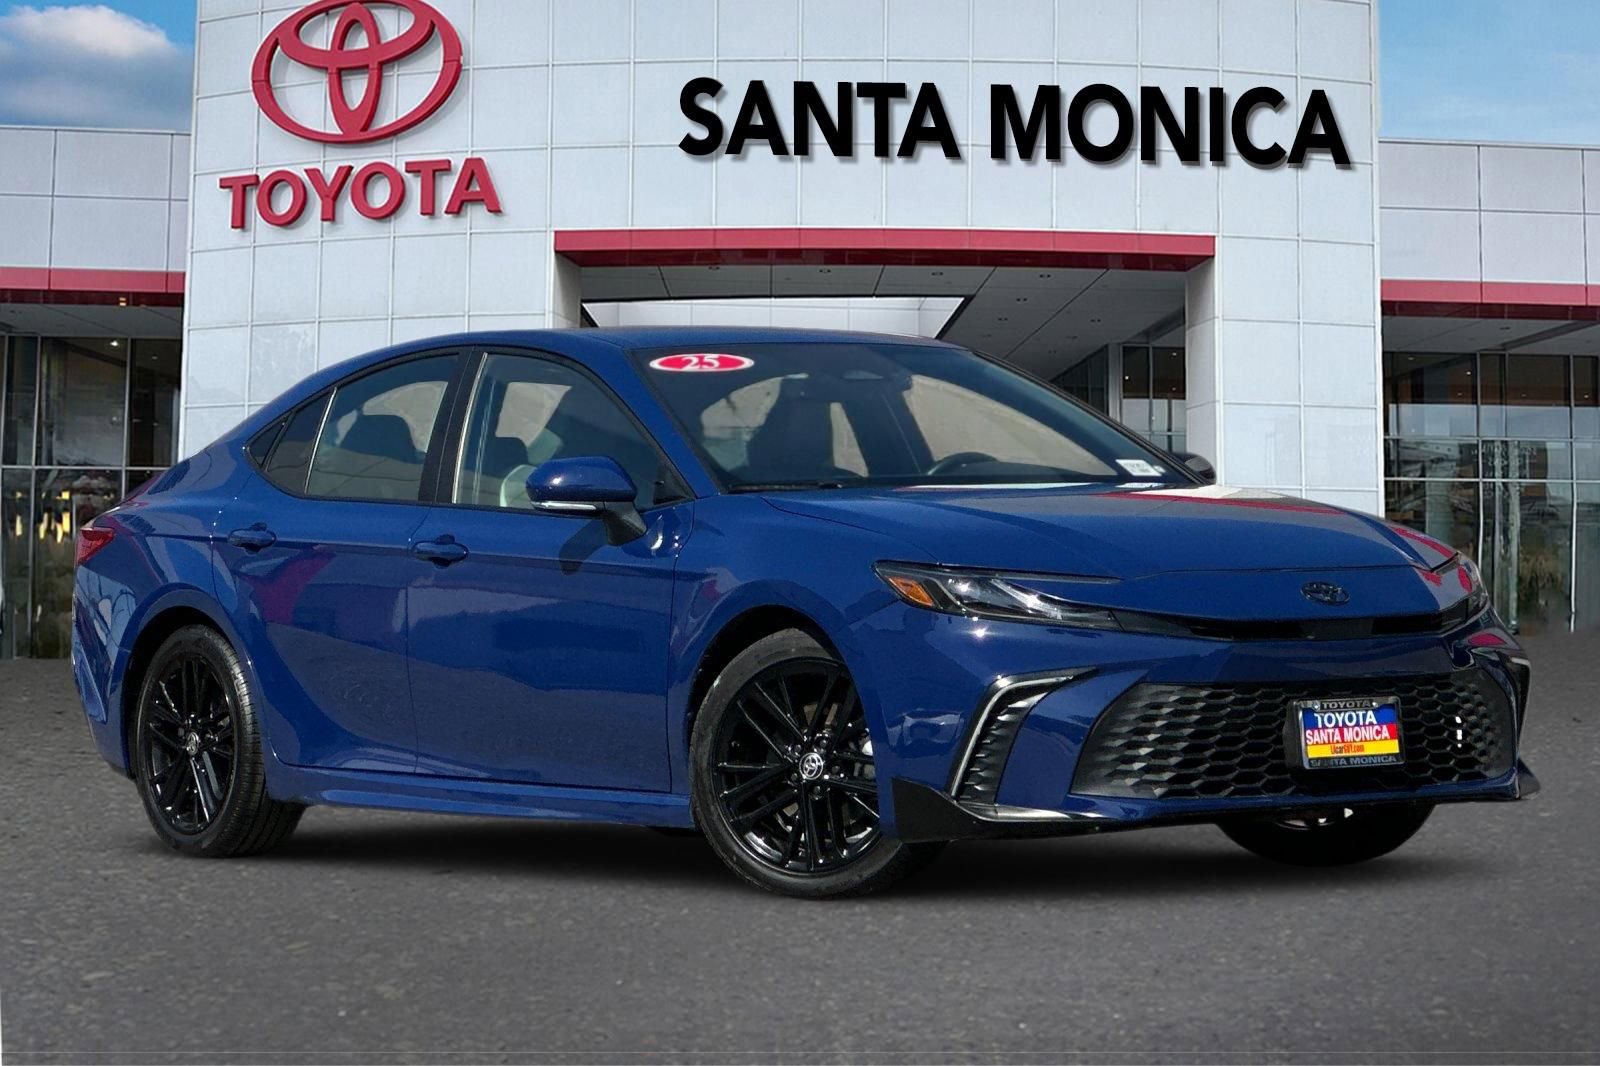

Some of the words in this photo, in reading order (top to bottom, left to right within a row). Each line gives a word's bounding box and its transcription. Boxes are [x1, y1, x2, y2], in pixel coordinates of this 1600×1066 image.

[679, 78, 961, 158] SANTA
[991, 84, 1351, 165] MONICA
[220, 158, 502, 229] TOYOTA
[682, 355, 720, 369] 25
[1323, 700, 1371, 709] TOYOTA
[1314, 710, 1377, 728] TOYOTA
[1306, 728, 1341, 745] SANTA
[1344, 725, 1390, 741] MONICA
[1349, 755, 1397, 765] MONICA
